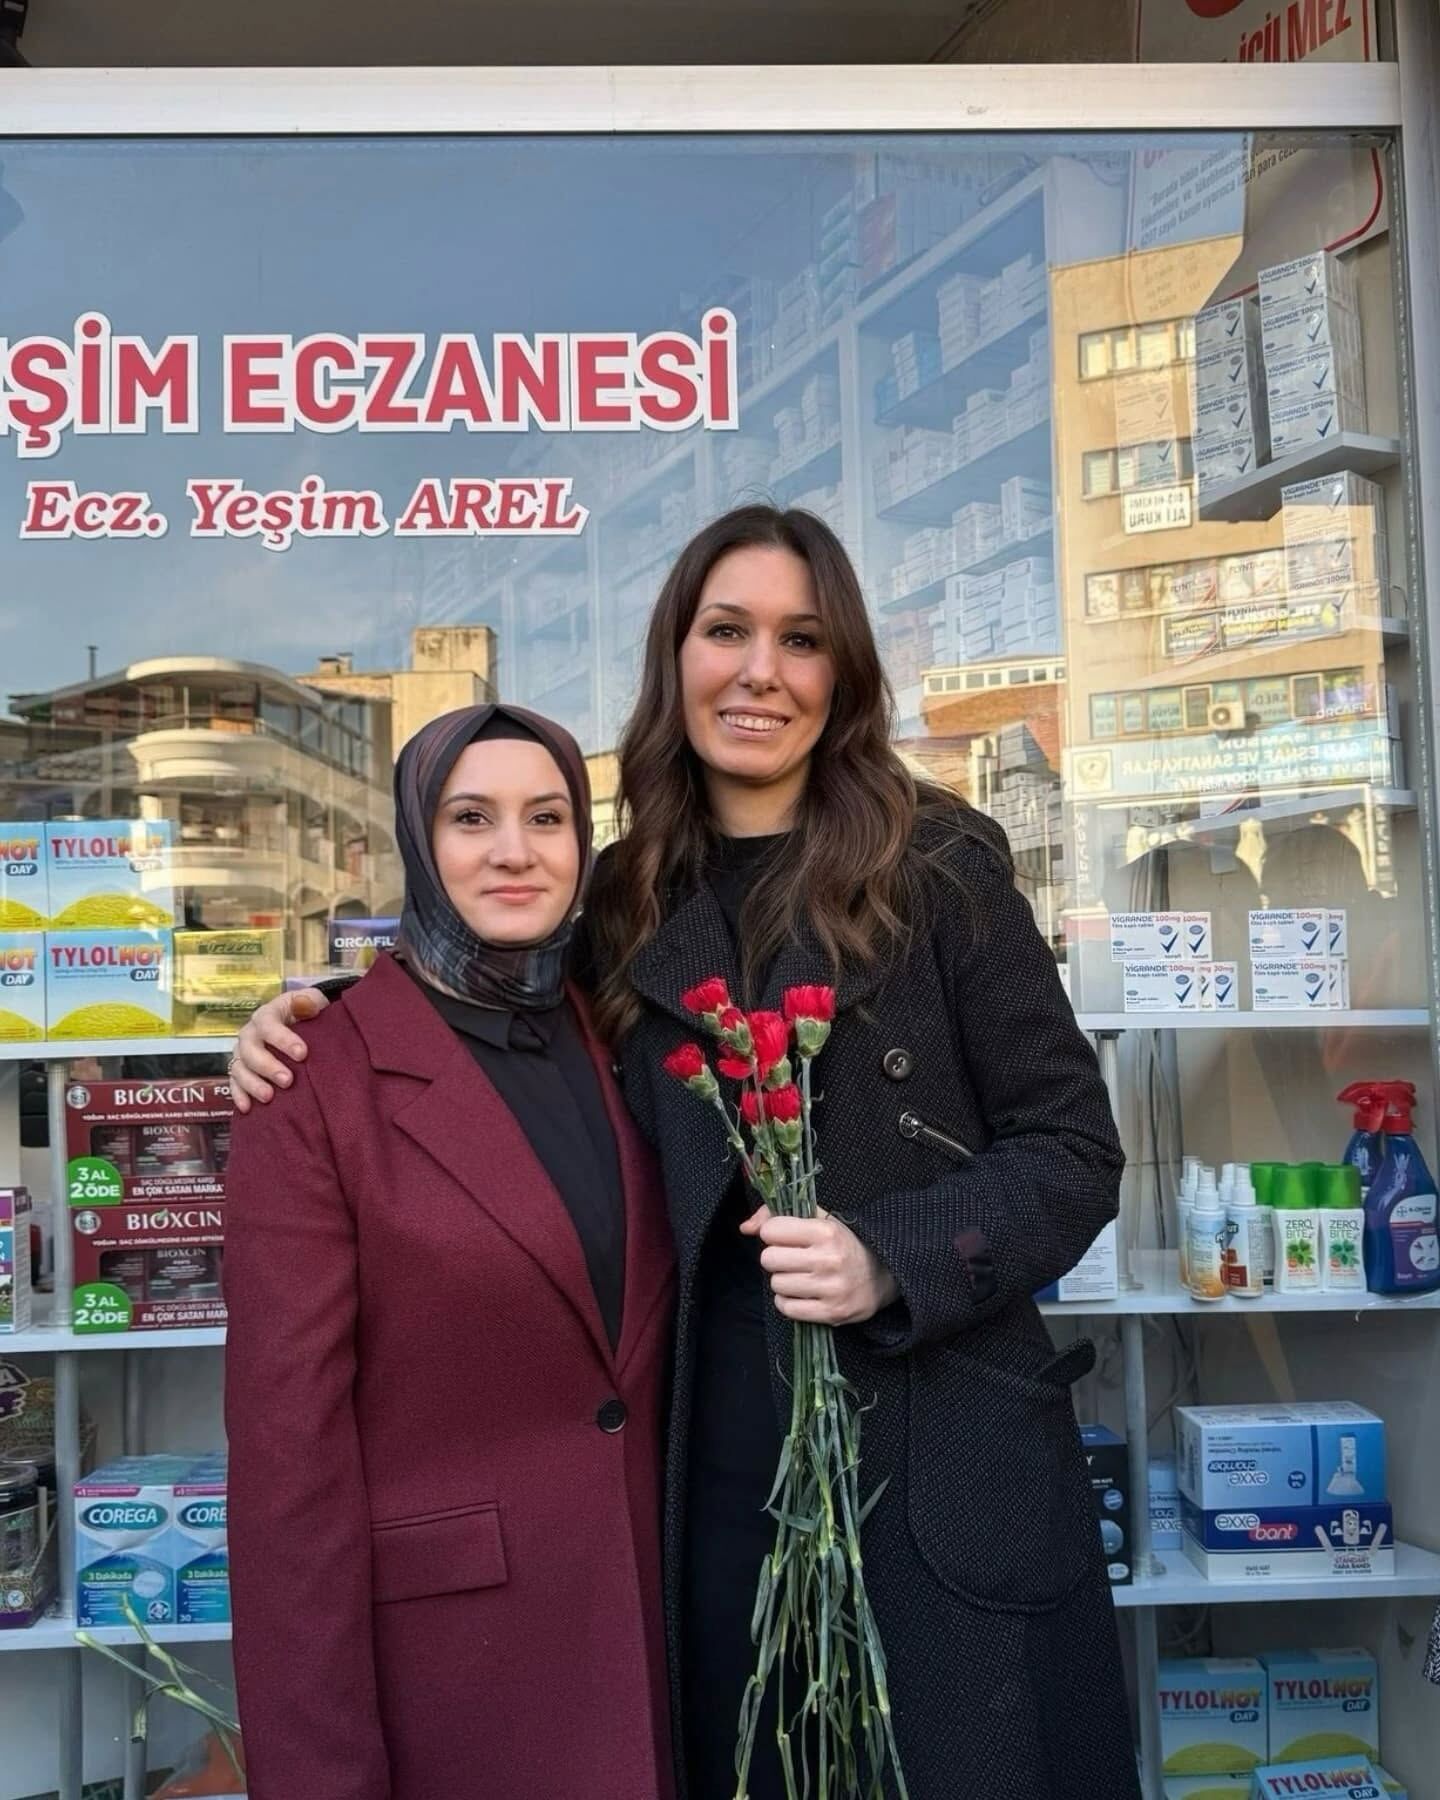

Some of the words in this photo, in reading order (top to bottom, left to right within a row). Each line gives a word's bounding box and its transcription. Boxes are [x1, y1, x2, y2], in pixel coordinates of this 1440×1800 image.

[223, 308, 737, 432] ECZANESİ
[21, 481, 167, 538] Ecz.
[187, 475, 388, 551] Yeşim
[395, 477, 588, 536] AREL
[8, 863, 33, 875] DAY
[51, 944, 164, 967] TYLOLHOT
[5, 974, 30, 985] DAY
[135, 970, 158, 980] DAY
[114, 1087, 205, 1106] BIOXCIN
[143, 1125, 191, 1136] BIOXCIN
[78, 1167, 88, 1181] 3
[90, 1168, 110, 1180] AL
[70, 1183, 85, 1198] 2
[84, 1182, 121, 1197] ÖDE
[132, 1186, 145, 1196] EN
[145, 1185, 164, 1198] ÇOK
[164, 1184, 193, 1195] SATAN
[127, 1210, 222, 1230] BIOXCIN
[1285, 1219, 1314, 1230] ZERO
[1329, 1219, 1360, 1230] ZERO
[84, 1293, 96, 1307] 3
[99, 1296, 119, 1307] AL
[74, 1309, 89, 1325] 2
[90, 1309, 129, 1324] ÖDE
[141, 1313, 155, 1322] EN
[156, 1312, 176, 1324] ÇOK
[176, 1311, 205, 1321] SATAN
[1228, 1472, 1268, 1486] exxe
[88, 1508, 159, 1524] COREGA
[1216, 1515, 1259, 1529] exxe
[1256, 1525, 1295, 1541] bant
[1273, 1678, 1374, 1700] TYLOLHOT
[1159, 1690, 1263, 1710] TYLOLHOT
[1346, 1700, 1367, 1711] DAY
[1233, 1711, 1255, 1722] DAY
[1267, 1768, 1374, 1796] TYLOLHOT
[1353, 1788, 1374, 1800] DAY
